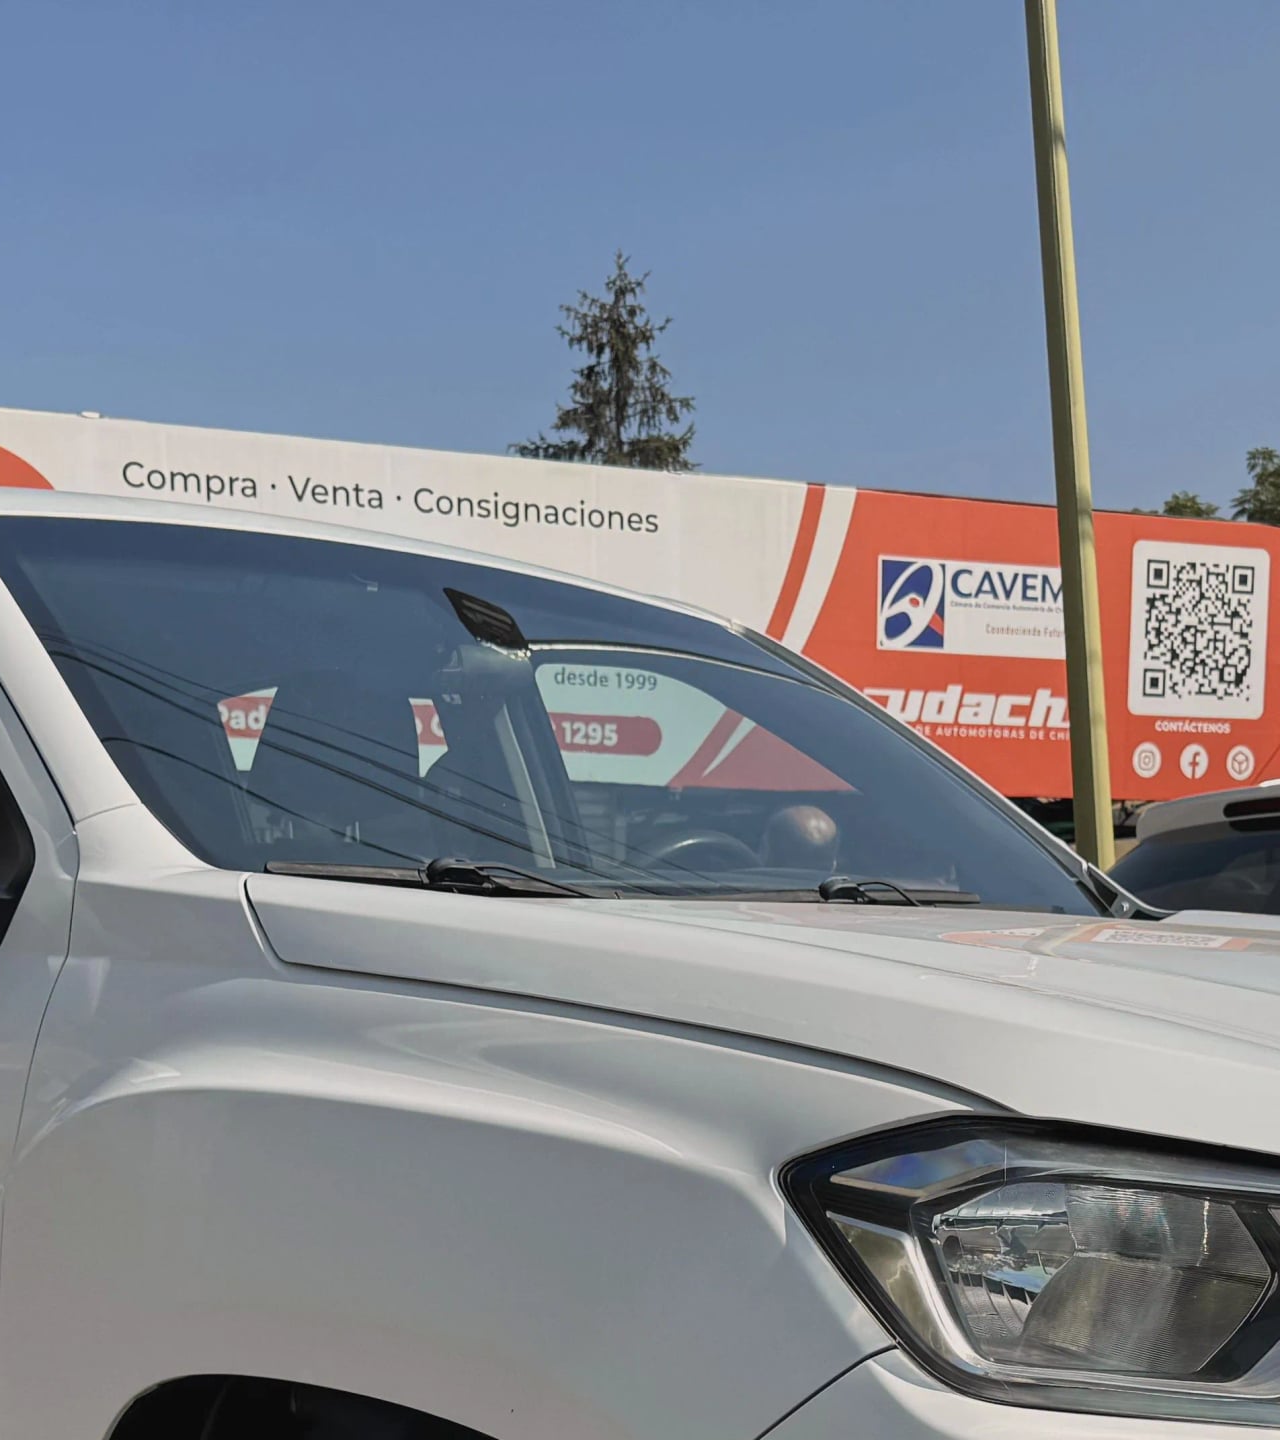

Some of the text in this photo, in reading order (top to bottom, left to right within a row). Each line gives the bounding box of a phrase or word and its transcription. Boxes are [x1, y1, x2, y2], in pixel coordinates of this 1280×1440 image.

[121, 461, 659, 534] Compra Venta Consignaciones
[554, 666, 658, 692] desde 1999
[561, 720, 618, 747] 1295
[935, 726, 1025, 740] AUTOMOTORAS
[1029, 729, 1045, 741] DE
[1154, 719, 1232, 735] CONTÁCTENOS
